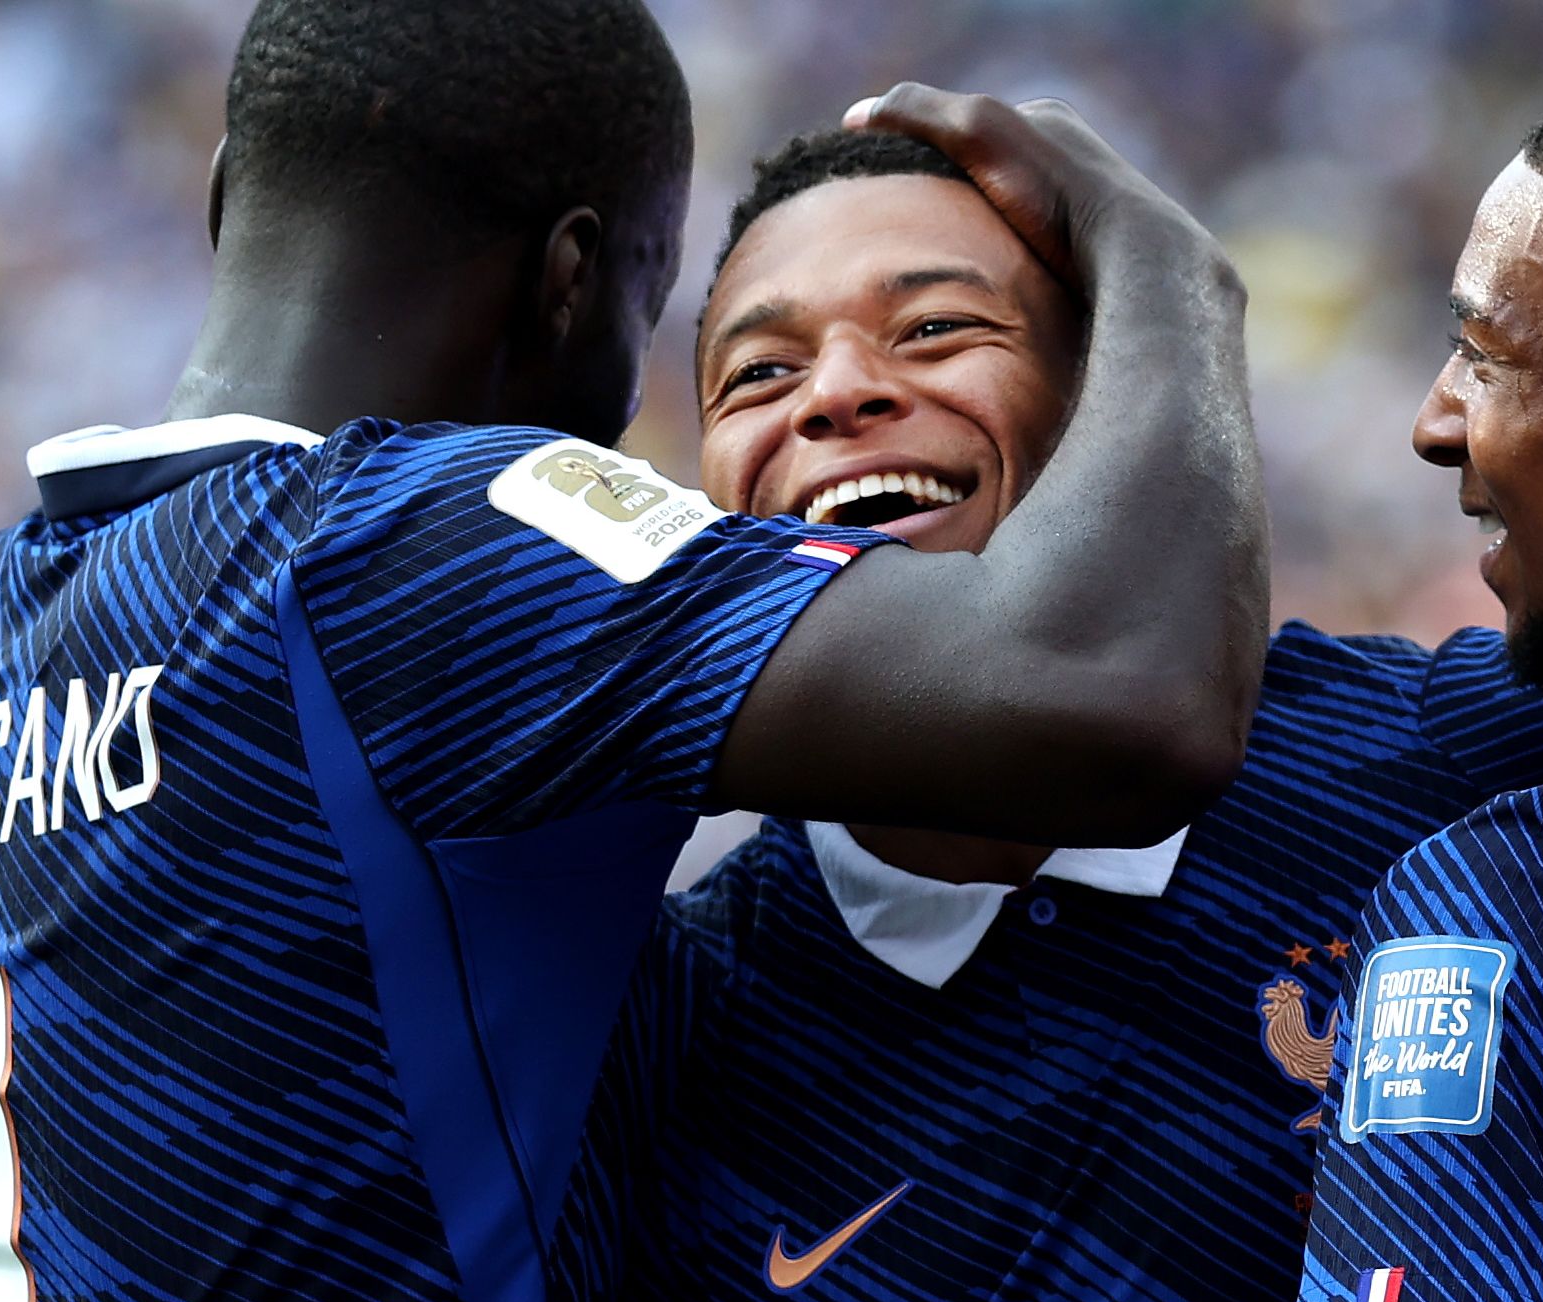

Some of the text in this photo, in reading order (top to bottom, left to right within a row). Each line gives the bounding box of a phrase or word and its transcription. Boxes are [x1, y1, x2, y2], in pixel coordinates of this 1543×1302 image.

[621, 490, 655, 511] FIFA
[632, 509, 670, 536] WORLD
[645, 508, 705, 547] 2026
[1376, 966, 1473, 1002] FOOTBALL
[1371, 997, 1472, 1041] UNITES
[1363, 1038, 1473, 1081] the World
